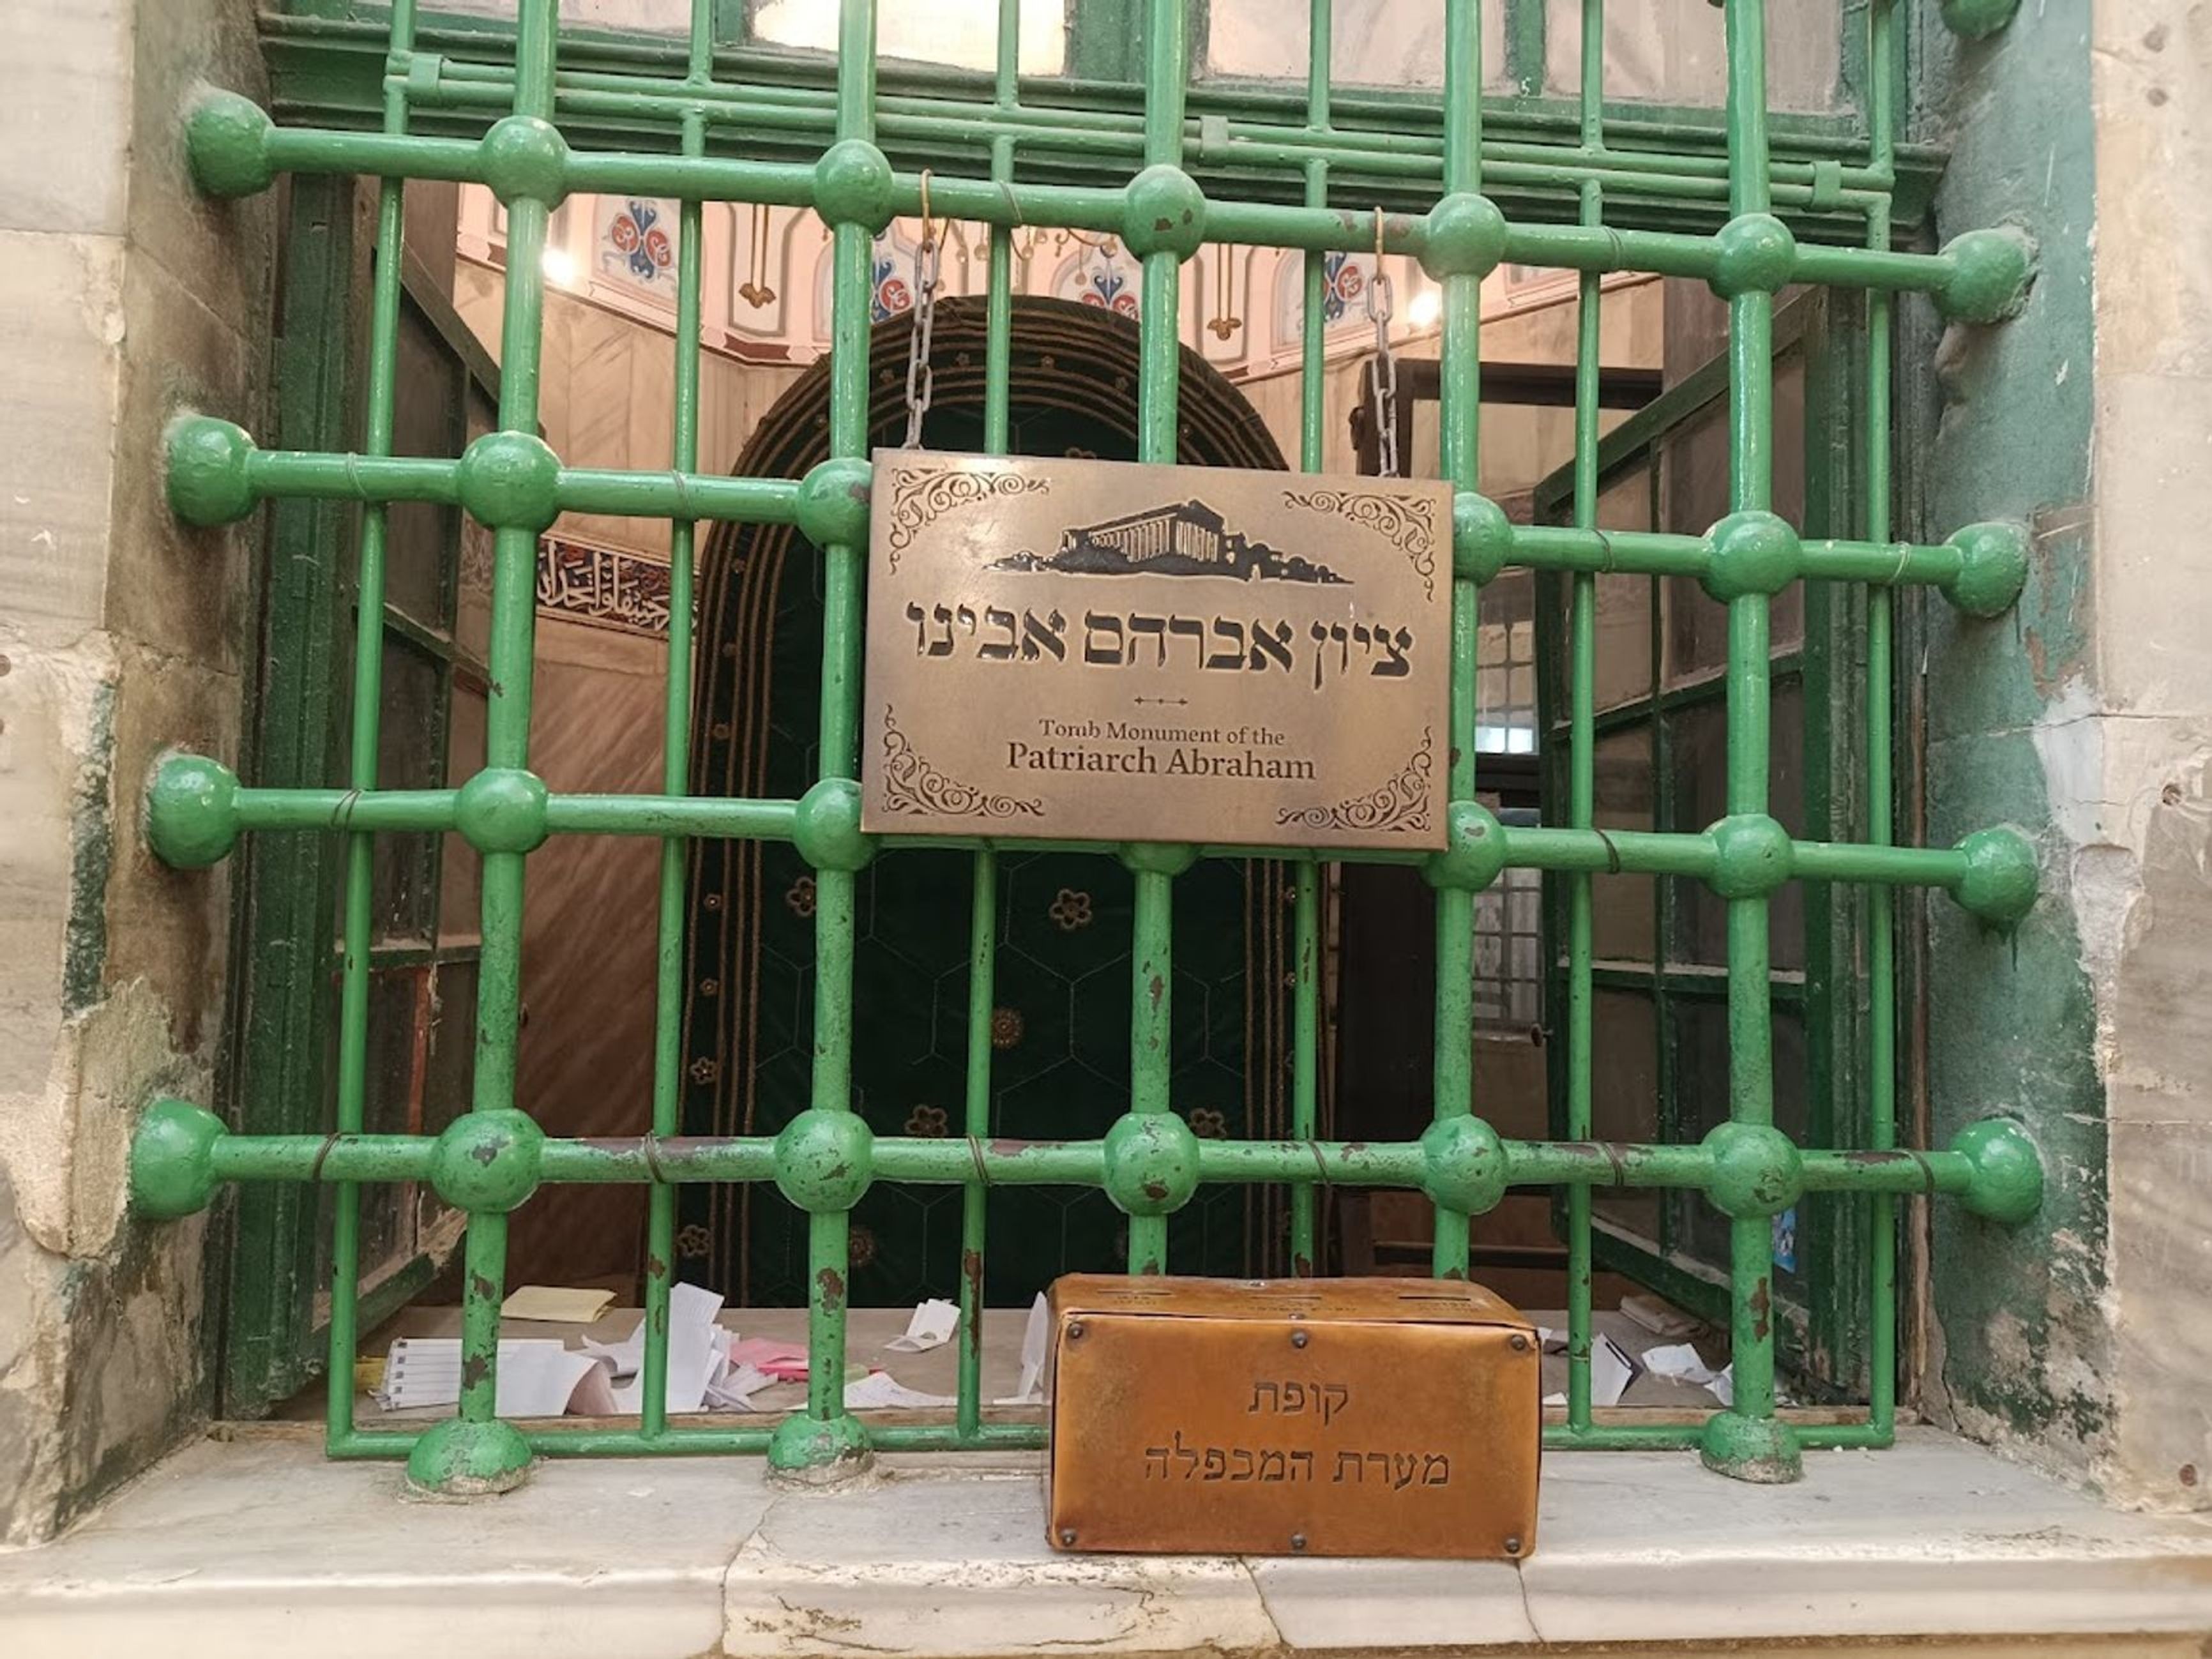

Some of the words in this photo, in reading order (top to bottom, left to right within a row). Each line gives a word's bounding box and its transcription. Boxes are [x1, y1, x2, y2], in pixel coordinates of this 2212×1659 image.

[907, 601, 1066, 662] אבינו
[1085, 609, 1293, 672] אברהם
[1311, 620, 1413, 690] ציון
[1039, 718, 1101, 738] Tomb
[1107, 722, 1221, 743] Monument
[1227, 725, 1250, 745] of
[1253, 727, 1285, 746] the
[1006, 741, 1158, 775] Patriarch
[1164, 748, 1317, 780] Abraham
[1248, 1381, 1349, 1427] קופת
[1146, 1430, 1314, 1482] המכפלה
[1333, 1450, 1449, 1490] מערת
